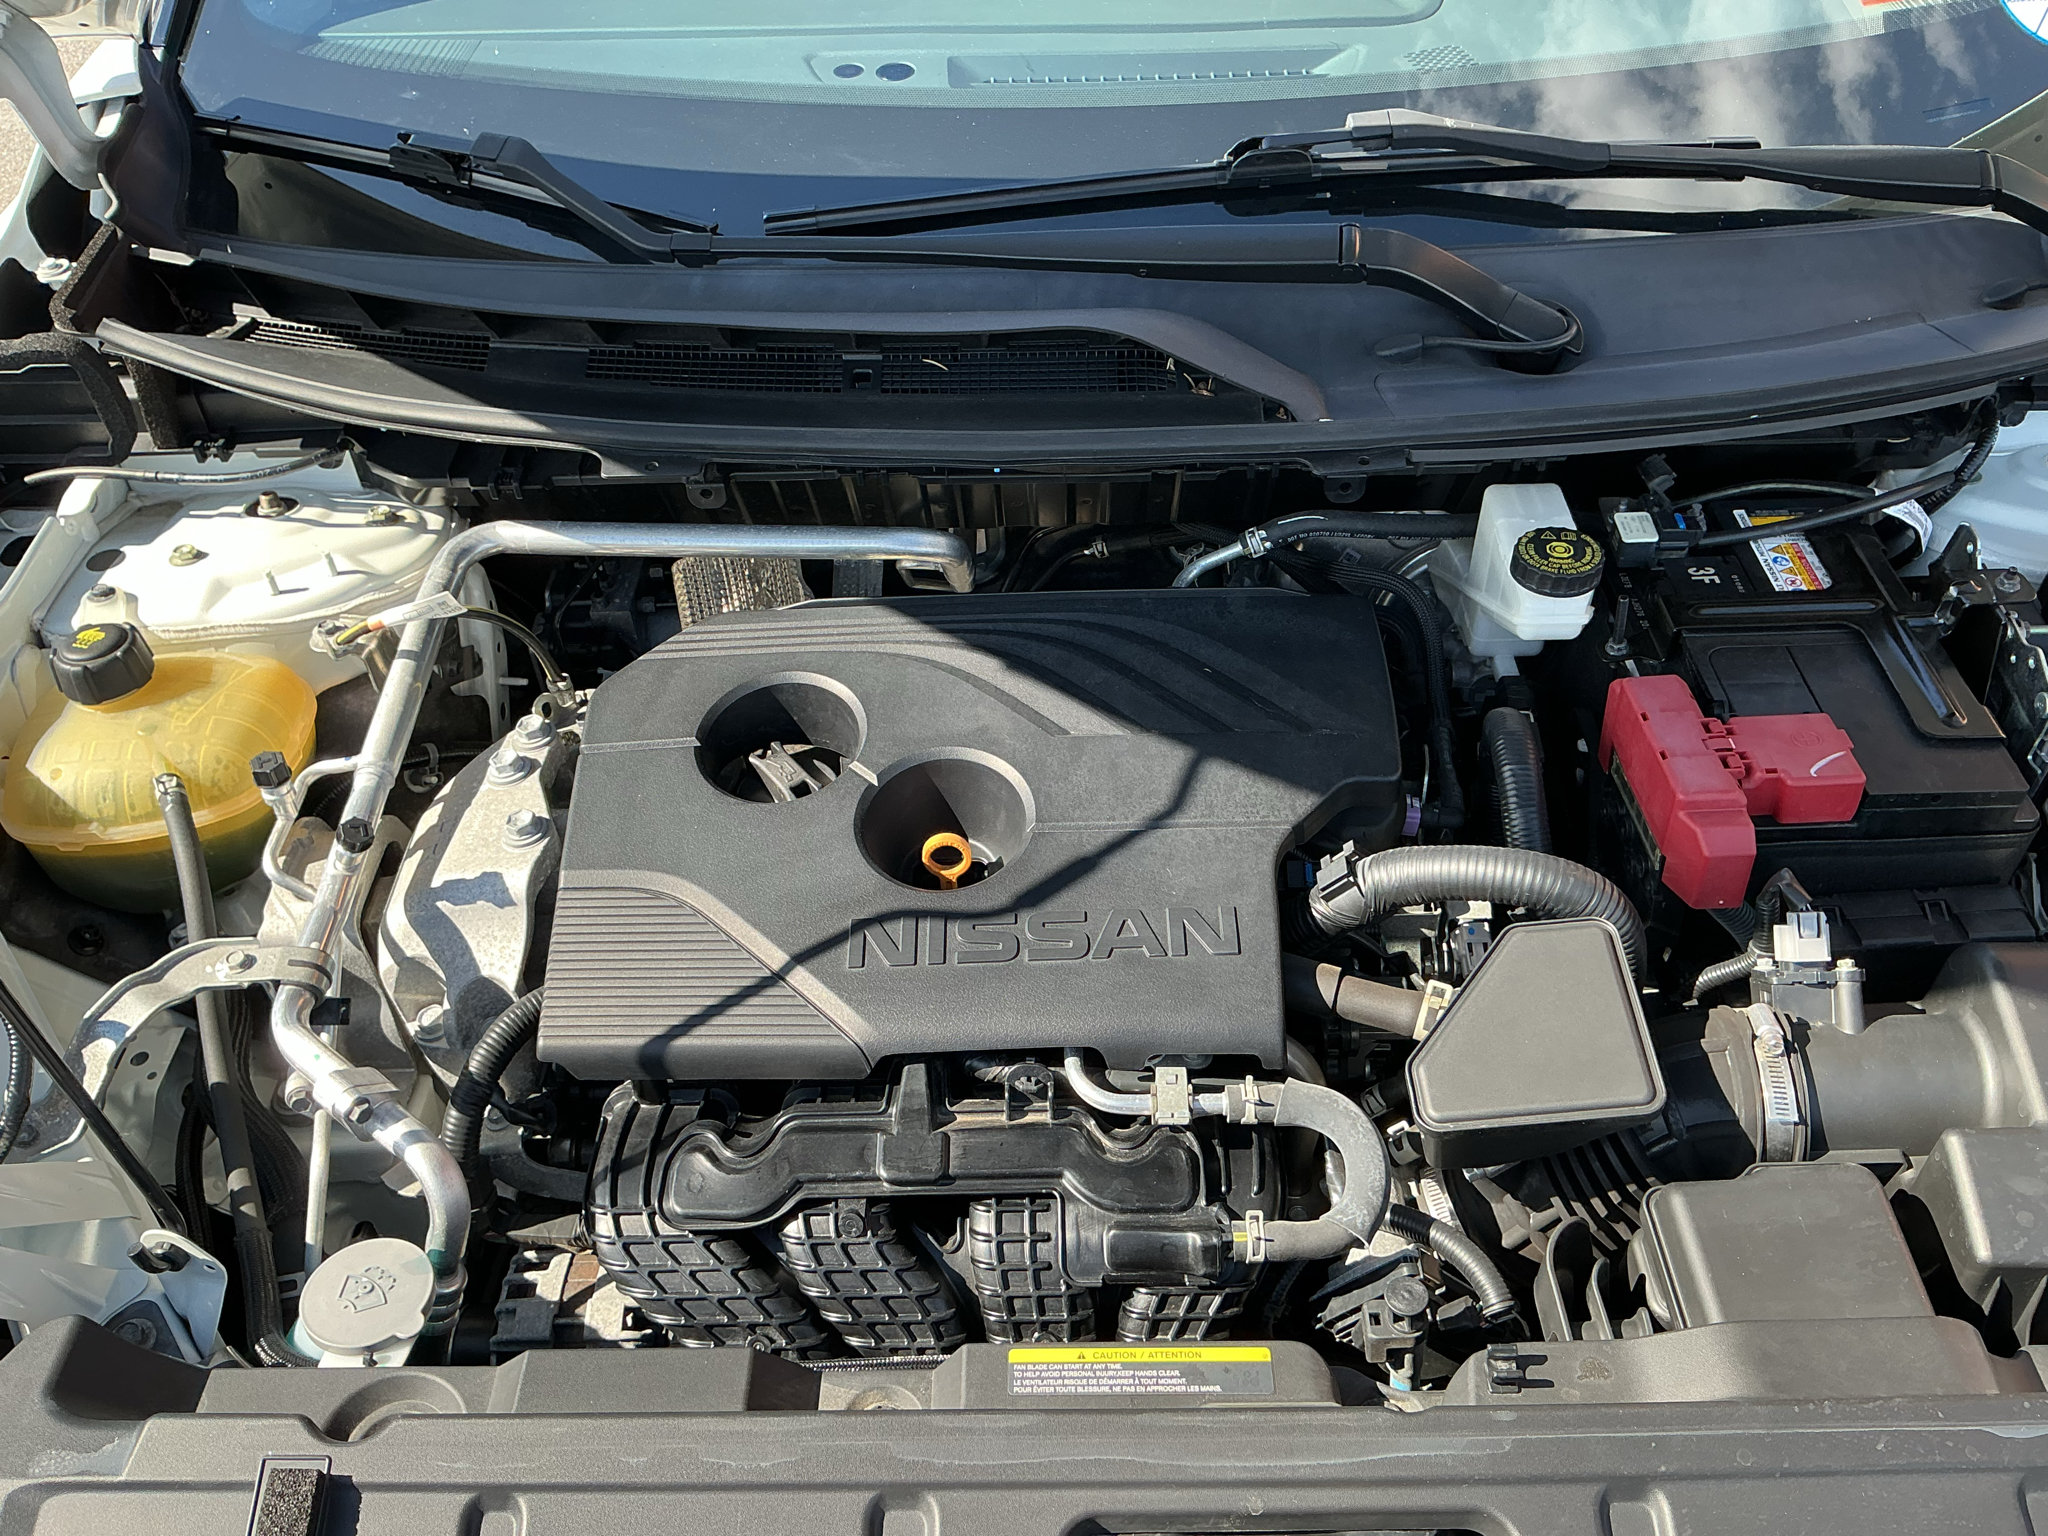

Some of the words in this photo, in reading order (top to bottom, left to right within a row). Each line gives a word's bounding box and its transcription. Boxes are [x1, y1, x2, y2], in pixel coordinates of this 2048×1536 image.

[1687, 566, 1721, 585] 3F
[847, 906, 1242, 969] NISSAN
[1093, 1351, 1137, 1359] CAUTION
[1148, 1351, 1202, 1359] ATTENTION
[1061, 1370, 1095, 1378] PERSONAL
[1098, 1377, 1134, 1385] DÉMARRER
[1134, 1376, 1140, 1385] À
[1033, 1385, 1055, 1393] ÉVITER
[1146, 1385, 1187, 1393] APPROCHER
[1187, 1385, 1200, 1393] LES
